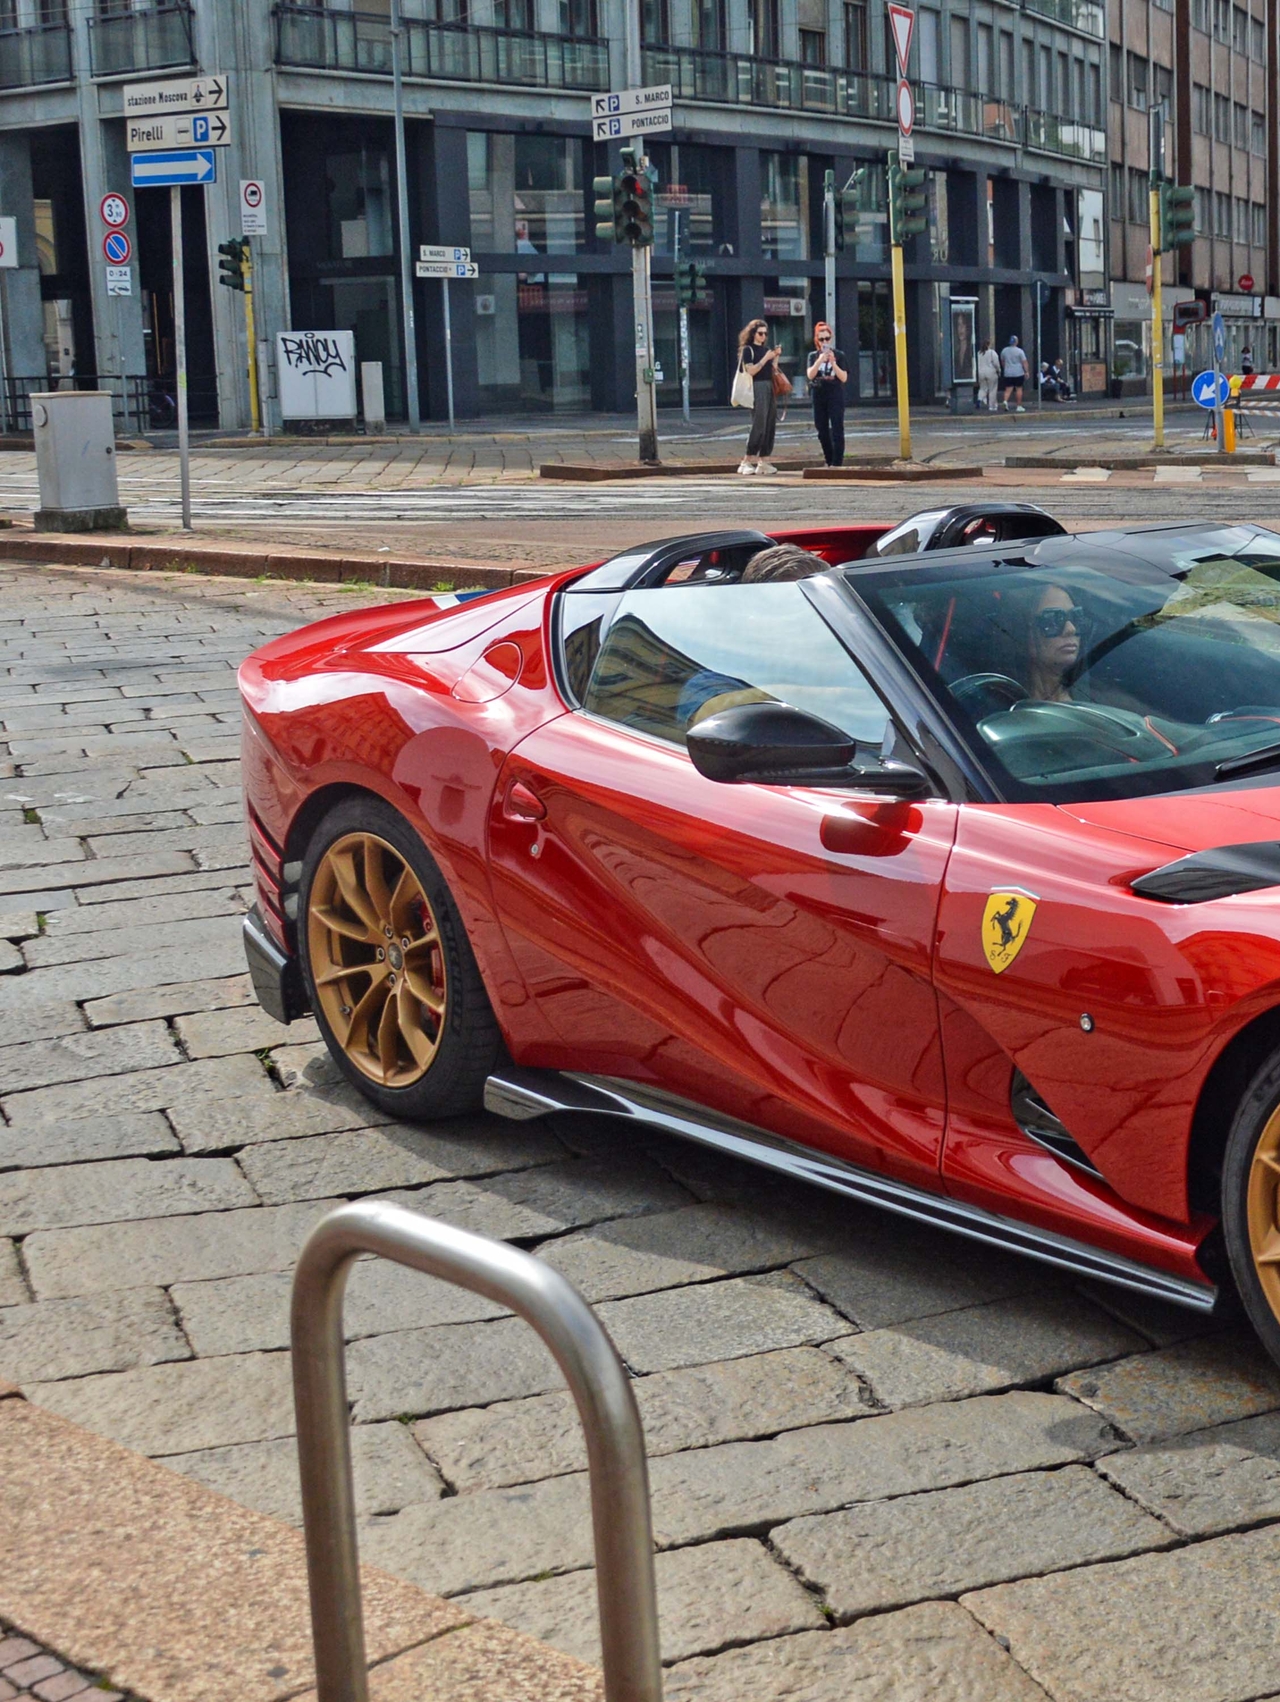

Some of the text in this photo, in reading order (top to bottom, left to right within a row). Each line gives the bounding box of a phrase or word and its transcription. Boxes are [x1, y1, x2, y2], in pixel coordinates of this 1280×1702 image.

[127, 91, 188, 106] stazione Moscova
[644, 91, 670, 103] MARCO
[632, 115, 668, 128] PONTACCIO
[131, 126, 163, 142] Pirelli
